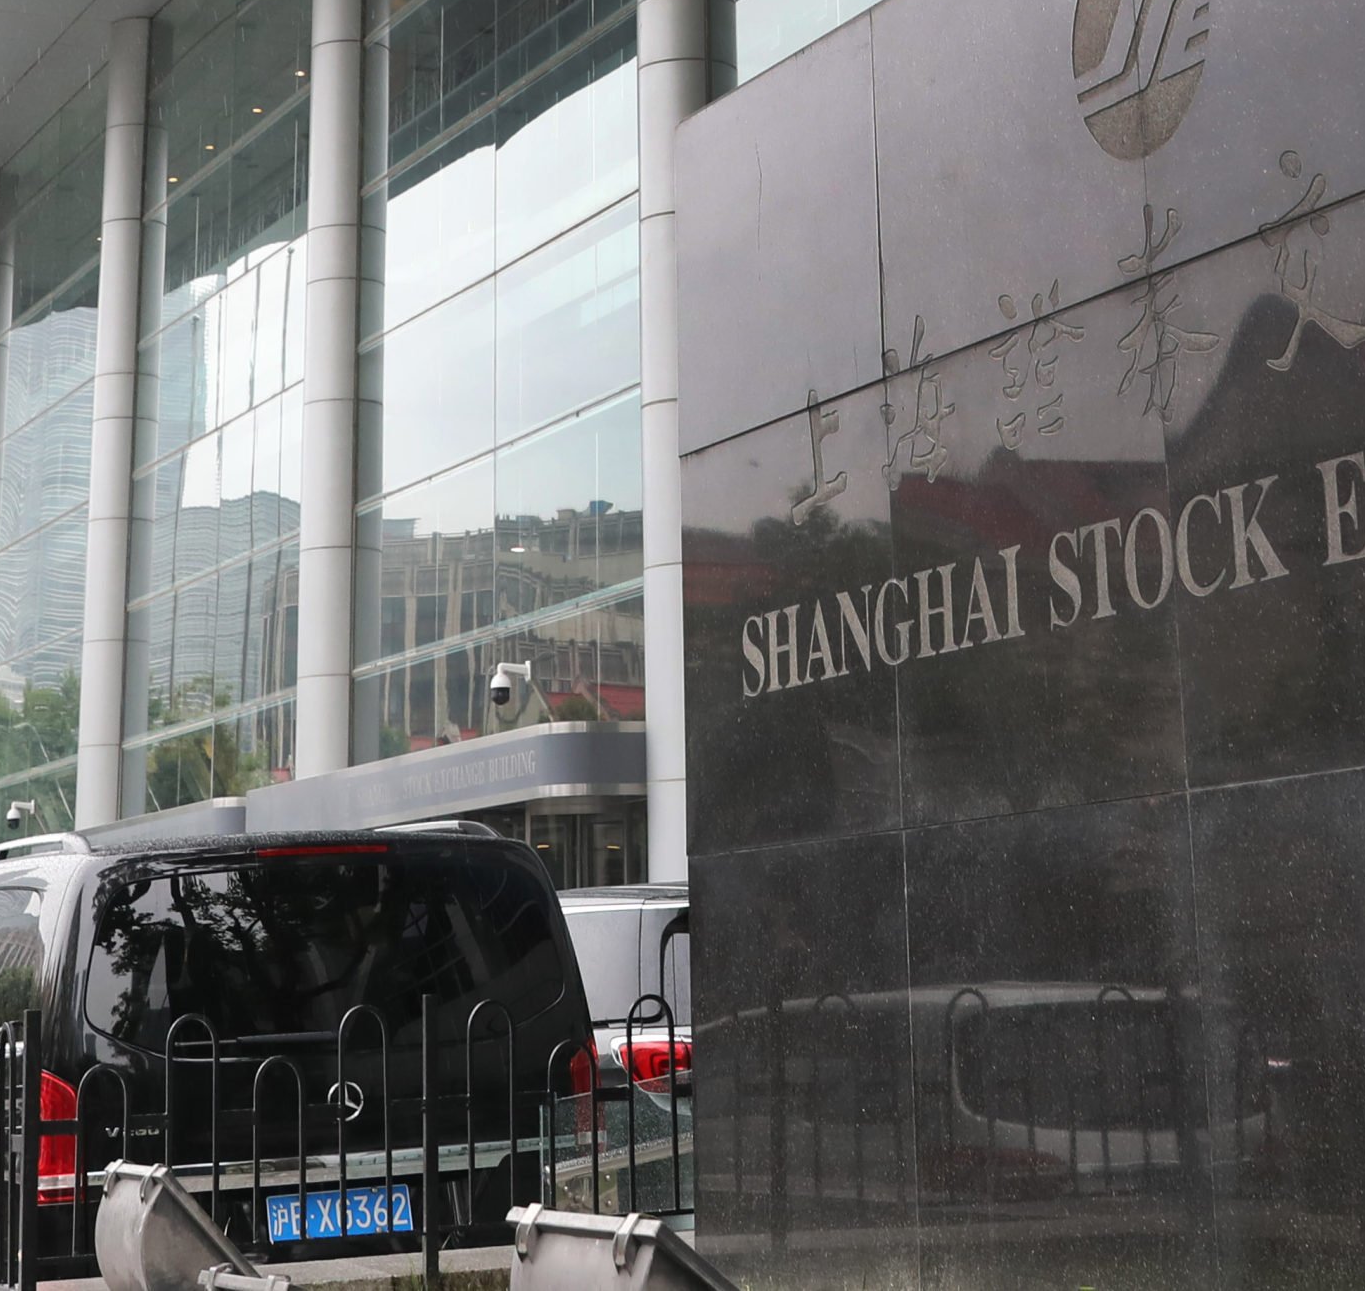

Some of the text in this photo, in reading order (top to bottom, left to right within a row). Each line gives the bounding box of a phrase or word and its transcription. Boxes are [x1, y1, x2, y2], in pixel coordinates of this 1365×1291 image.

[741, 543, 1023, 699] SHANGHAI
[1048, 473, 1289, 633] STOCK
[489, 749, 537, 783] BUILDING
